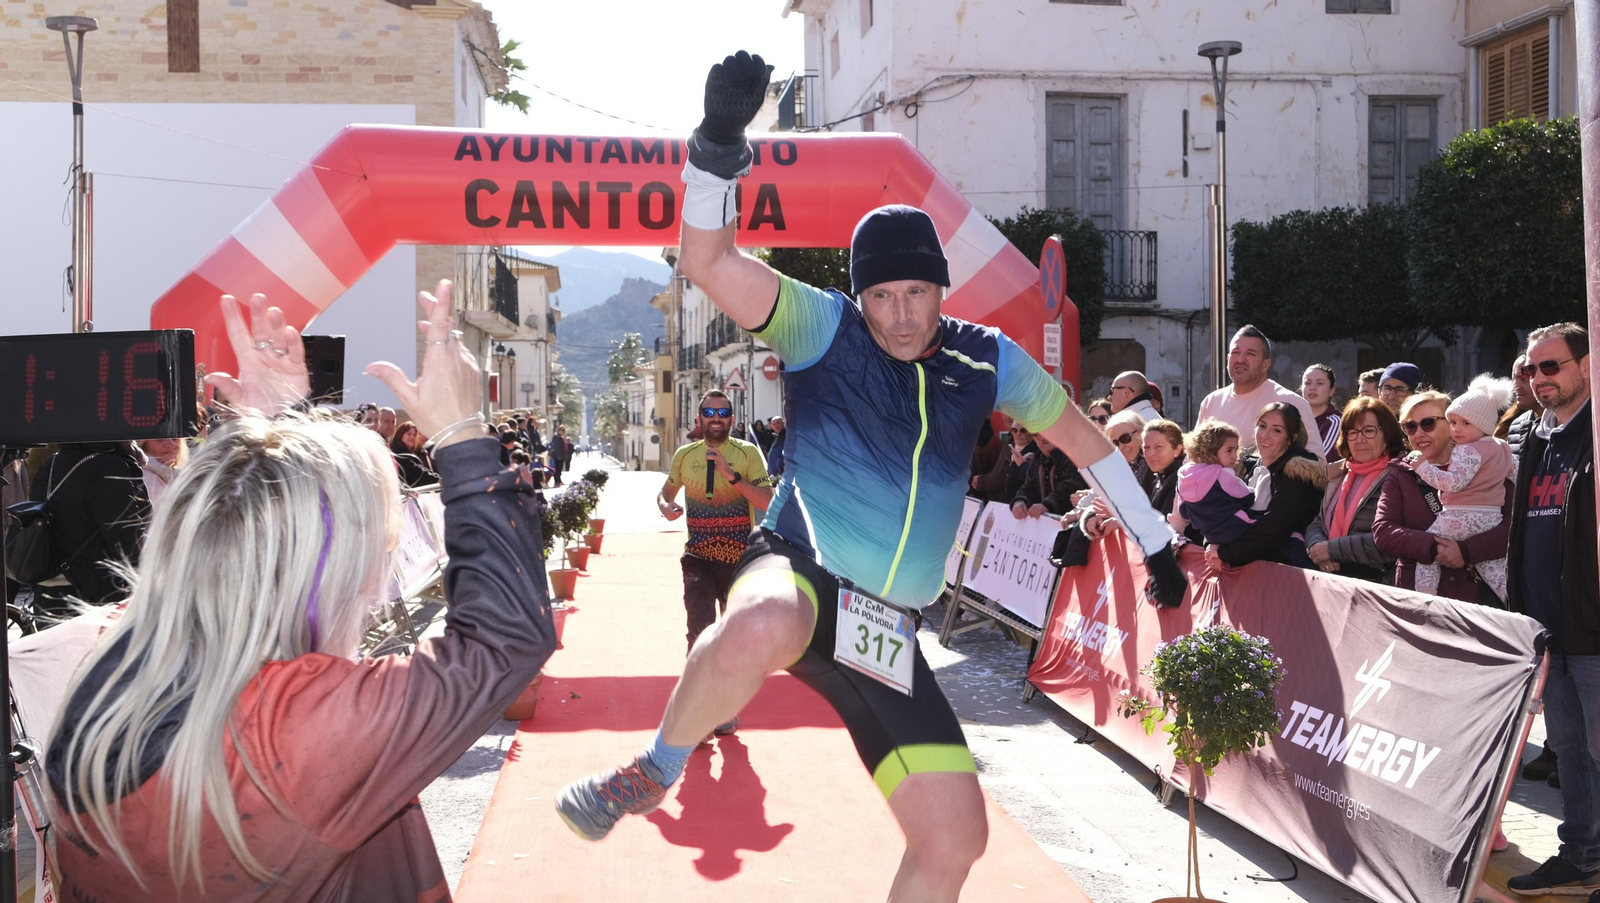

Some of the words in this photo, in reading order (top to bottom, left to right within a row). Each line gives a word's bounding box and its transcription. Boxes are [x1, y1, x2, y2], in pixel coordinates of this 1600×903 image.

[454, 135, 798, 166] AYUNTAMITO
[464, 178, 787, 231] CANTOIA
[1424, 491, 1441, 515] BIMB
[1528, 472, 1568, 508] HH
[983, 544, 1051, 599] CANTORIA
[850, 605, 860, 616] LA
[854, 594, 864, 606] IV
[865, 599, 885, 615] CxM
[855, 623, 904, 669] 317
[1281, 700, 1442, 789] TEAMERGY
[1294, 772, 1372, 821] www.teamergy.es
